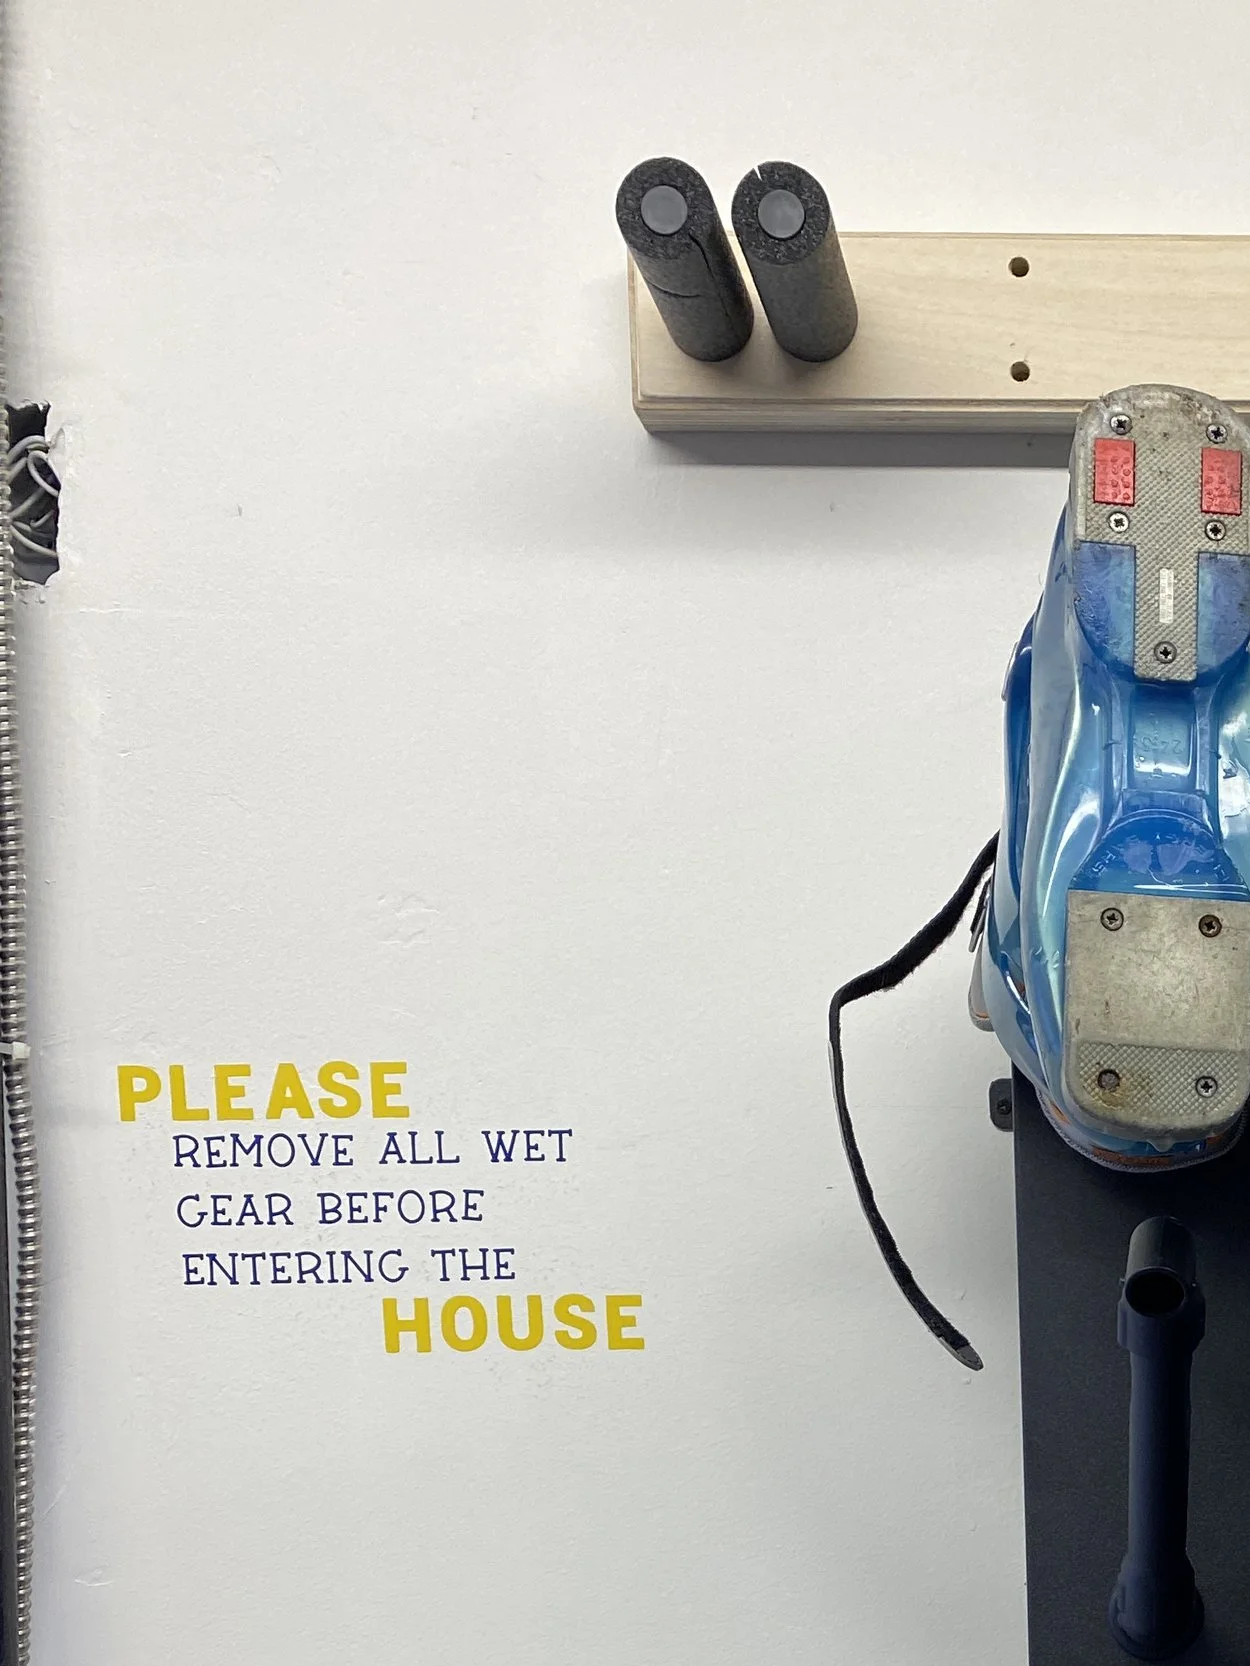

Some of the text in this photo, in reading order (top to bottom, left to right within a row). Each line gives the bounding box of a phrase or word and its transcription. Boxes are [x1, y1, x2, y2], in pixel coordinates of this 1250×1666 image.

[116, 1061, 410, 1122] PLEASE
[172, 1129, 573, 1169] REMOVE ALL WET
[176, 1189, 484, 1228] GEAR BEFORE
[182, 1247, 516, 1287] ENTERING THE
[382, 1294, 645, 1354] HOUSE
